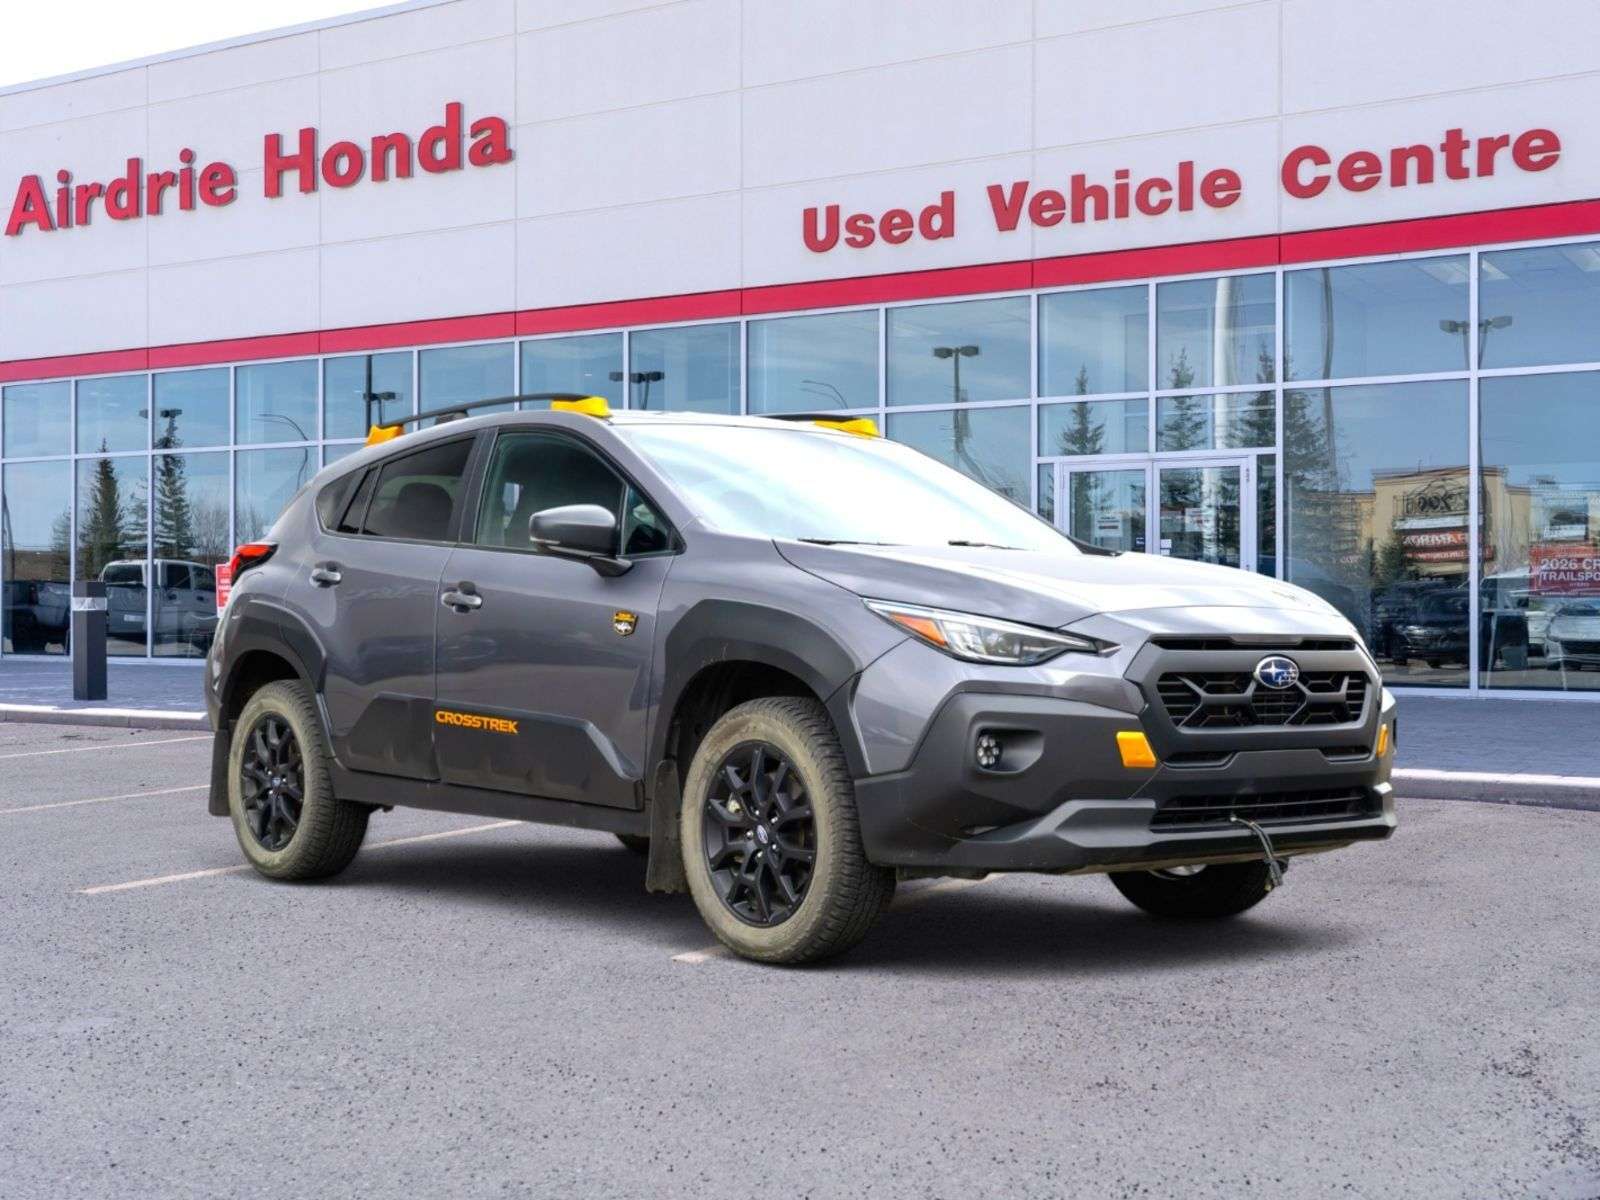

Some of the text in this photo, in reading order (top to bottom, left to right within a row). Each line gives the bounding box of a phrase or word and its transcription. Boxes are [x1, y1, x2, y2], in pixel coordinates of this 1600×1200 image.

[5, 101, 513, 236] Airdrie Honda
[802, 127, 1562, 253] Used Vehicle Centre
[1541, 558, 1578, 570] 2026
[434, 710, 520, 735] CROSSTREK
